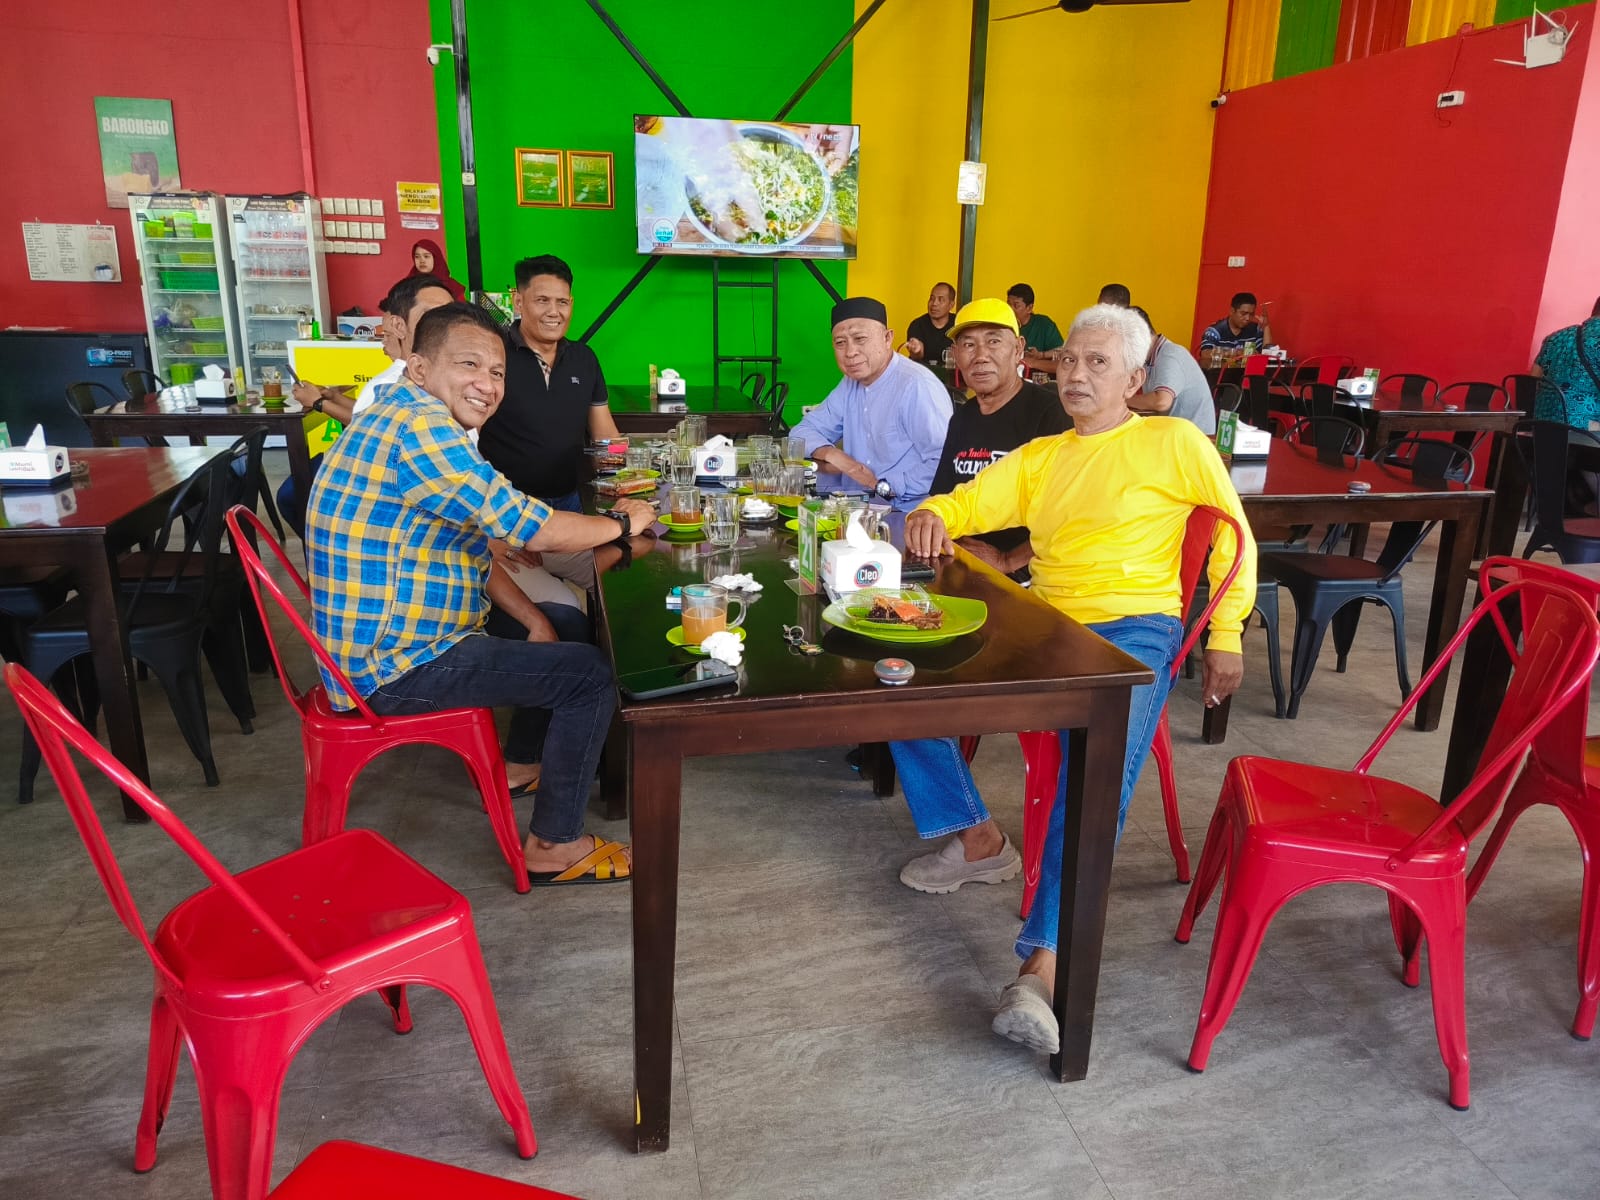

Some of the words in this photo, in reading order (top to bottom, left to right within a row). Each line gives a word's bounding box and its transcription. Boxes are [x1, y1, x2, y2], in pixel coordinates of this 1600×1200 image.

[102, 117, 169, 135] BARONGKO
[1221, 423, 1232, 447] 13
[802, 530, 812, 572] 21
[859, 568, 878, 581] Cleo
